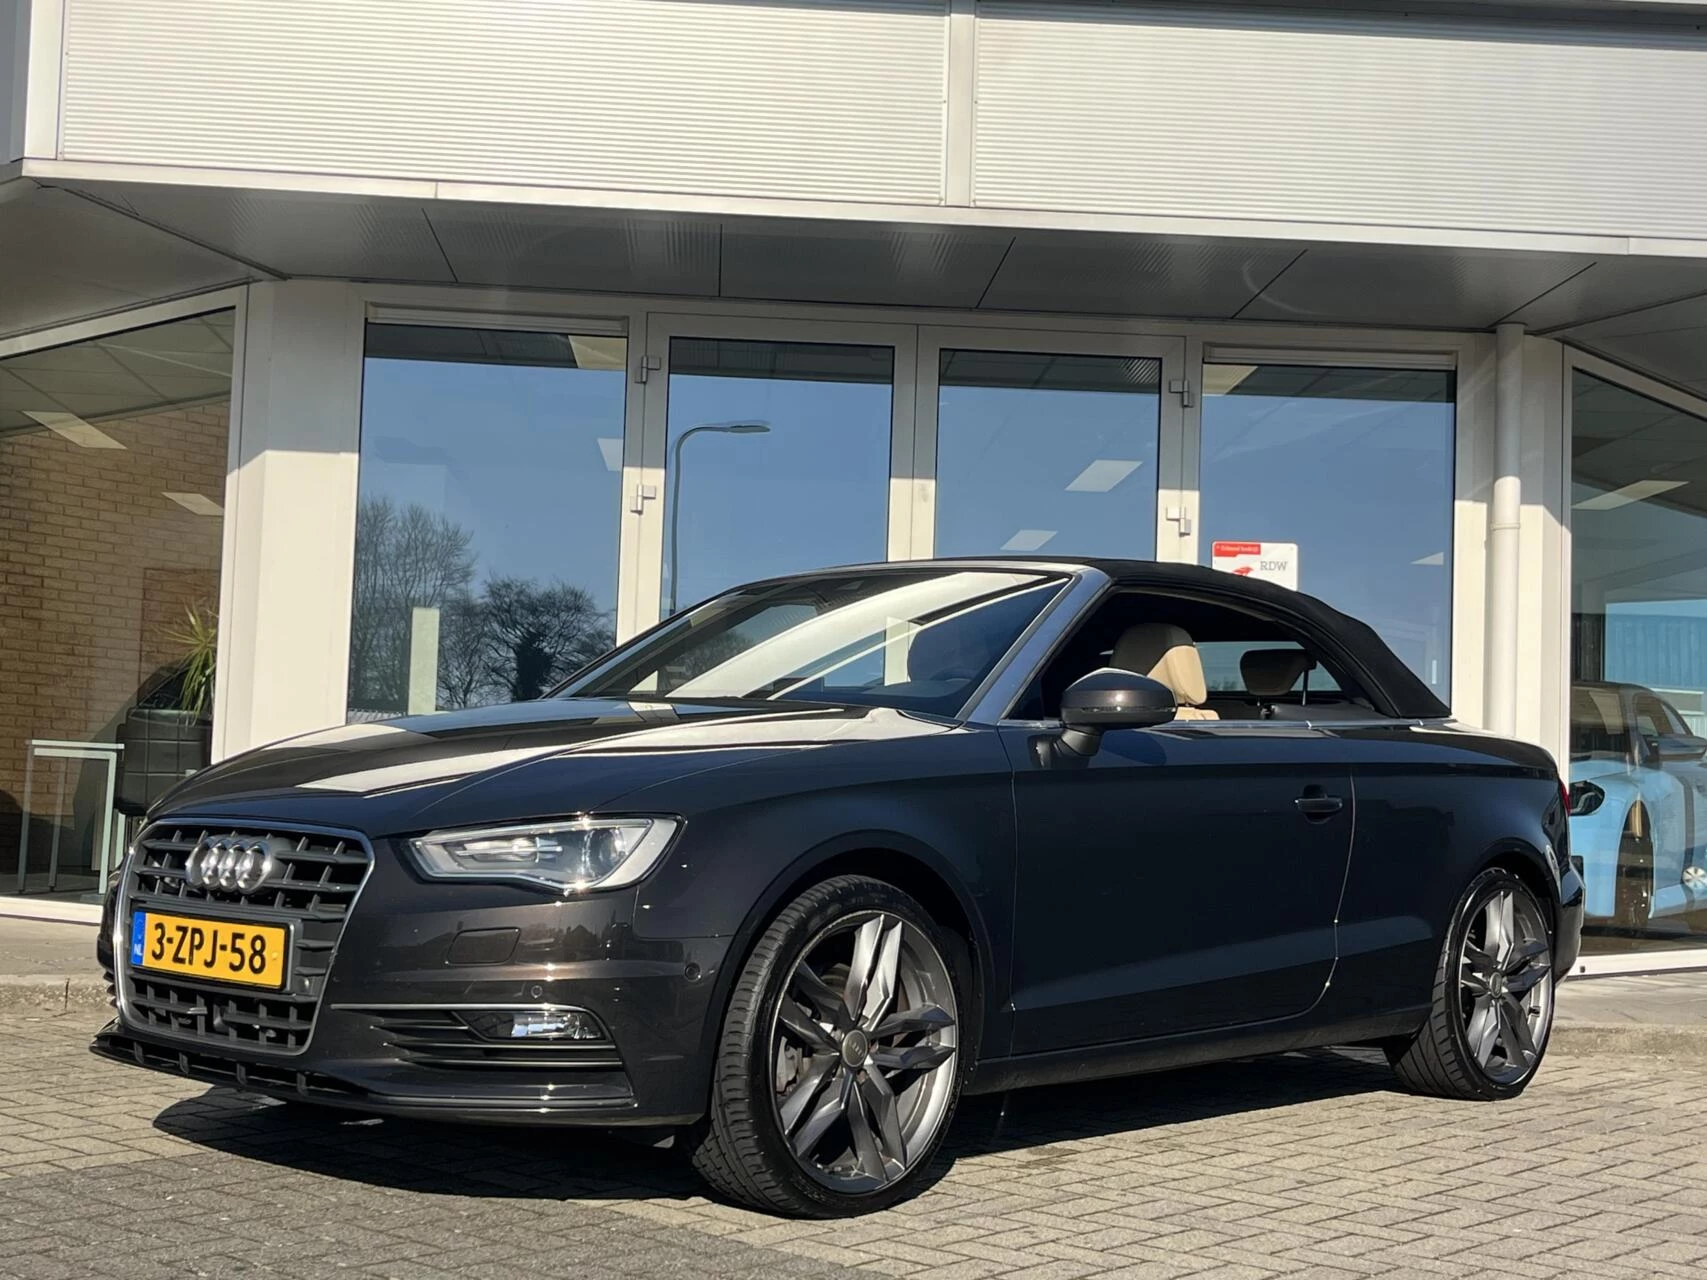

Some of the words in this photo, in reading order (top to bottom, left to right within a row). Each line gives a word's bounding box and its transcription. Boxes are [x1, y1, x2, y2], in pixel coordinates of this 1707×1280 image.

[1260, 560, 1287, 571] RDW
[133, 943, 143, 957] NL
[151, 922, 267, 975] 3-ZPJ-58
